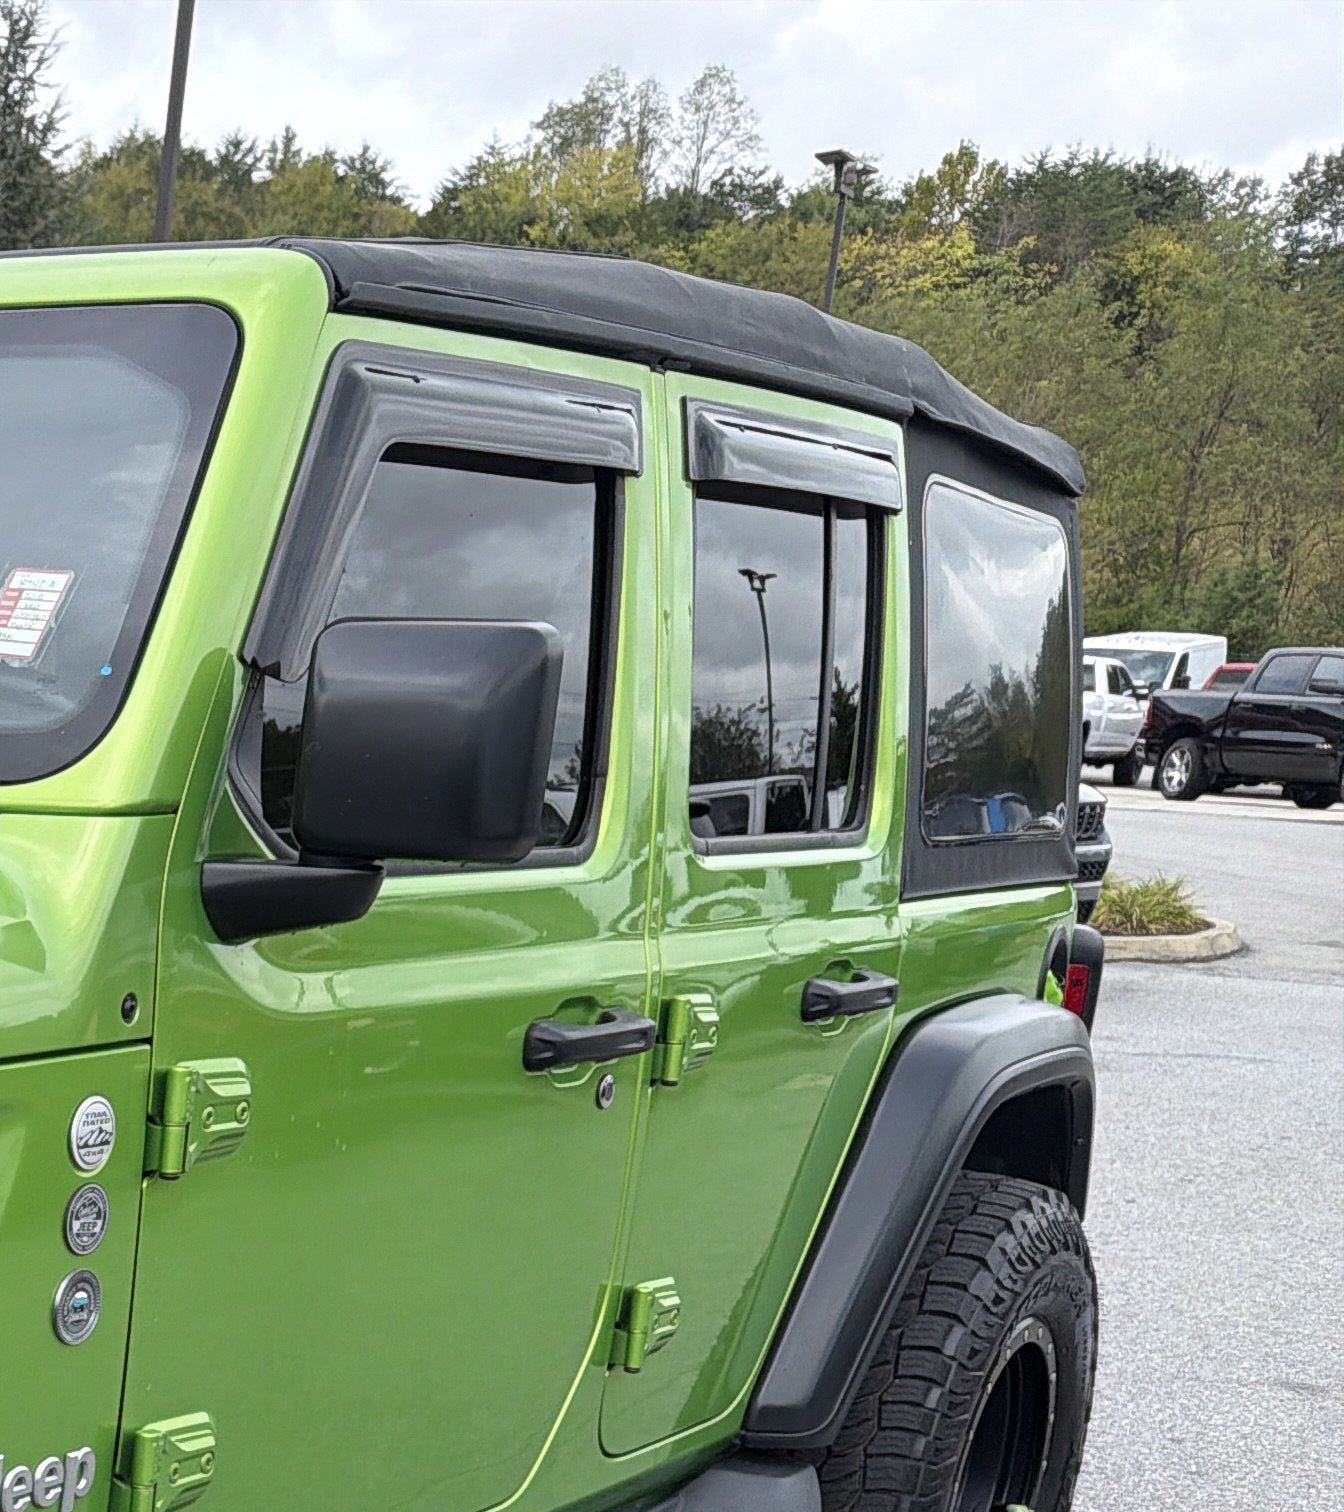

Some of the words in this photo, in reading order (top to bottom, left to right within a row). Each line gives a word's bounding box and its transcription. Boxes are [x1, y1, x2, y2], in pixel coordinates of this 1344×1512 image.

[84, 1111, 108, 1120] TRAIL
[82, 1117, 111, 1127] RATED
[77, 1221, 98, 1232] JEEP
